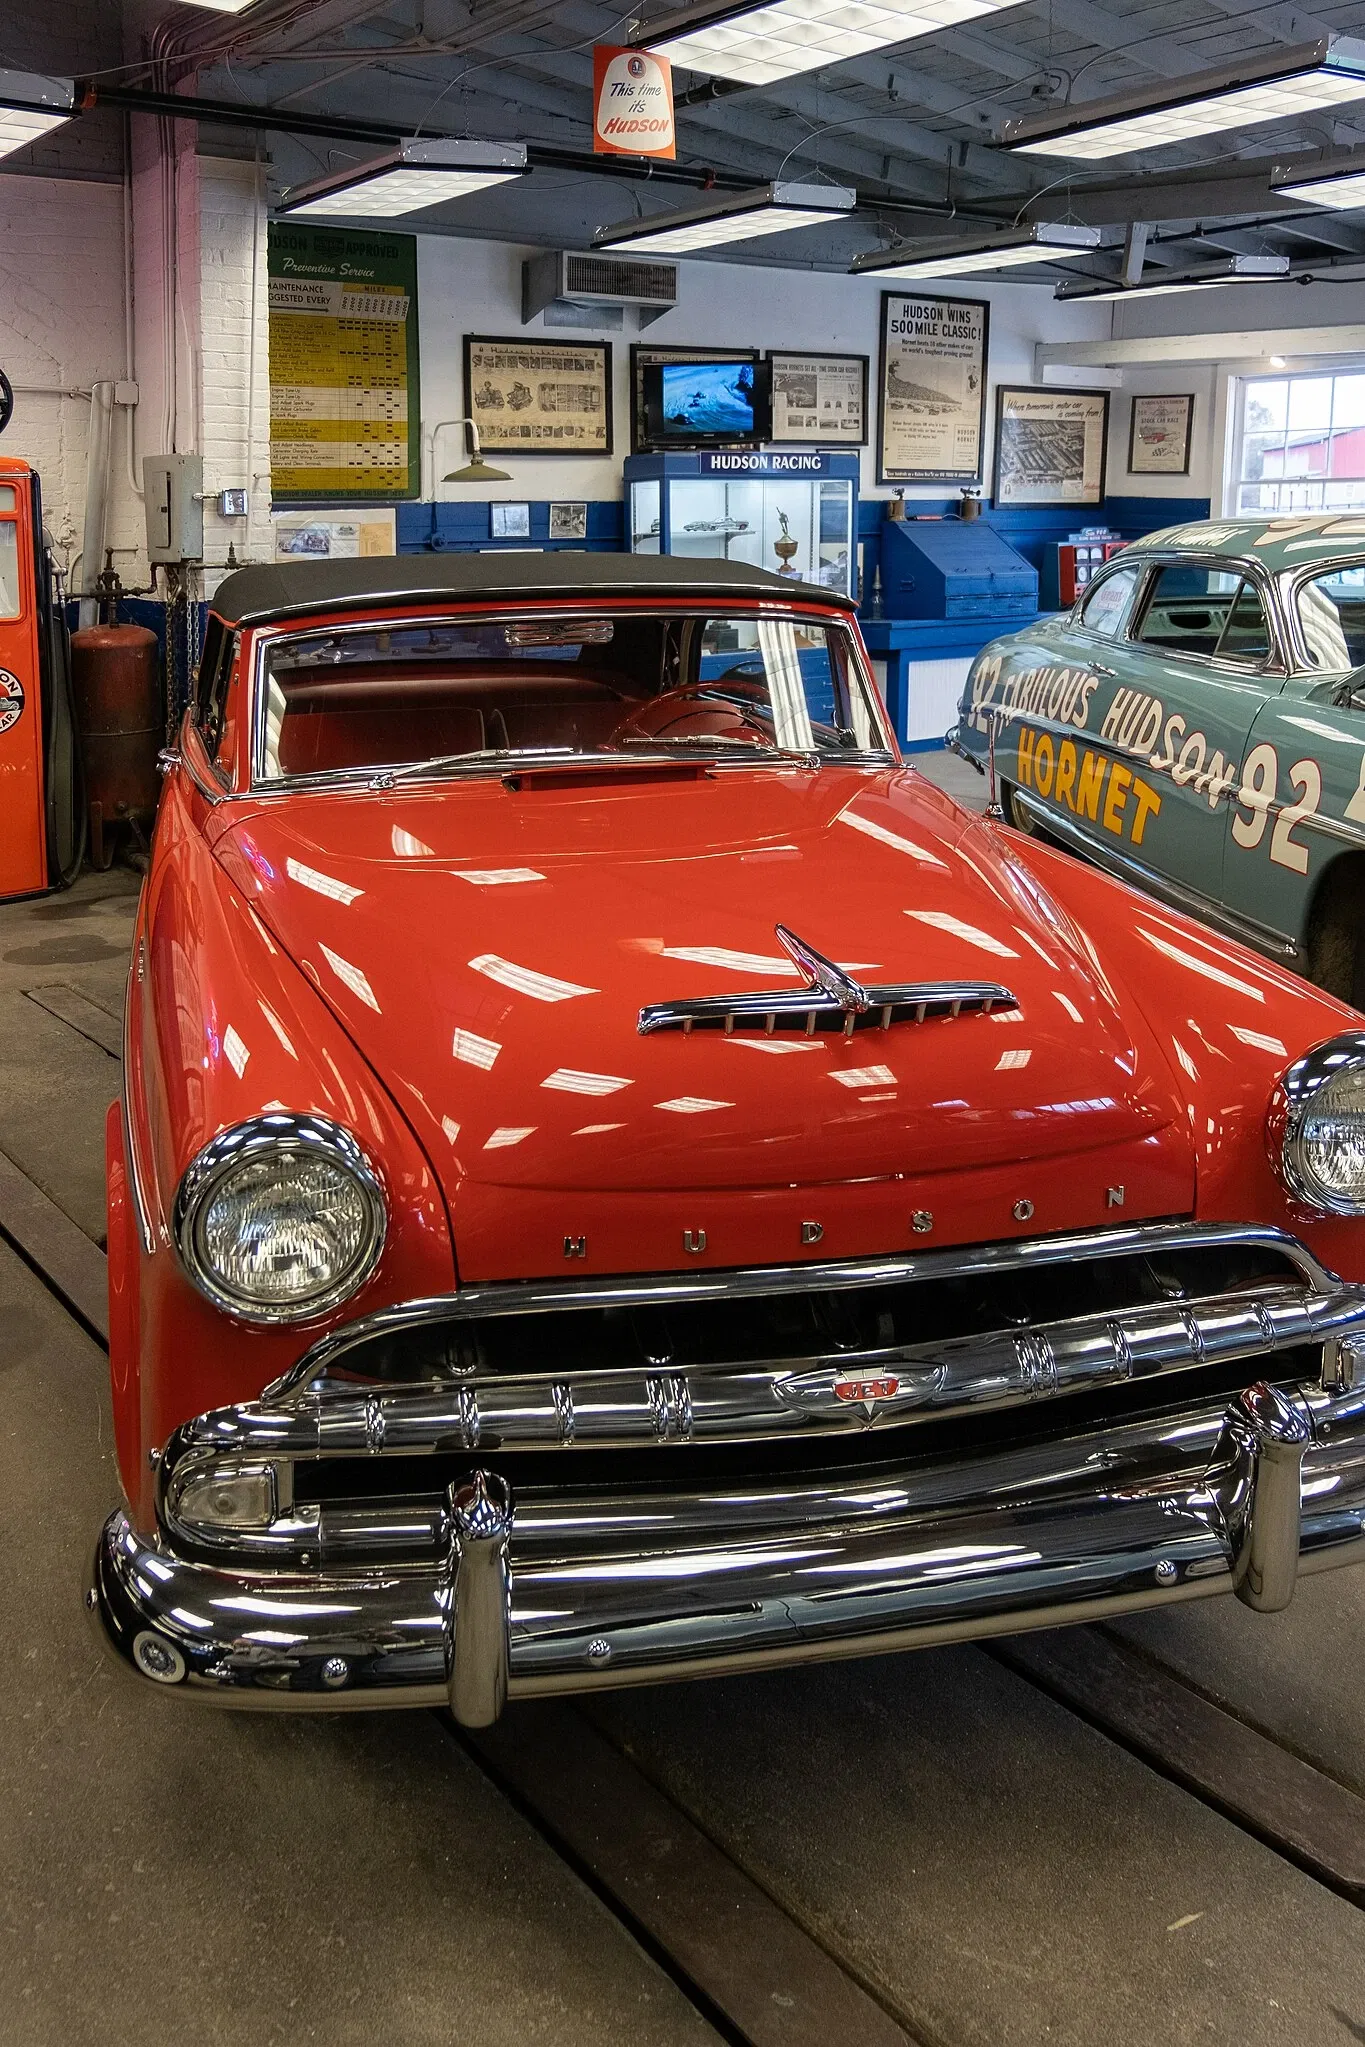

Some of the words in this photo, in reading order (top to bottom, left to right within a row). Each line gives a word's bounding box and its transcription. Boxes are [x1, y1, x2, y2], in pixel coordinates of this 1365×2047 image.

[610, 82, 635, 96] This
[638, 83, 662, 96] time
[628, 100, 646, 112] it's
[603, 118, 670, 134] HUDSON
[282, 257, 336, 274] Preventive
[340, 262, 375, 278] Service
[306, 295, 332, 304] EVERY
[903, 304, 943, 321] HUDSON
[947, 306, 971, 324] WINS
[890, 320, 913, 334] 500
[915, 322, 938, 336] MILE
[942, 324, 982, 341] CLASSIC!
[1007, 400, 1024, 412] Where
[1026, 400, 1054, 410] tomorrow's
[711, 455, 768, 470] HUDSON
[772, 455, 822, 470] RACING
[1017, 727, 1162, 847] HORNET
[1100, 687, 1236, 810] HUDSON
[1232, 742, 1310, 877] 92
[562, 1184, 1126, 1258] HUDSON
[844, 1381, 888, 1398] JET
